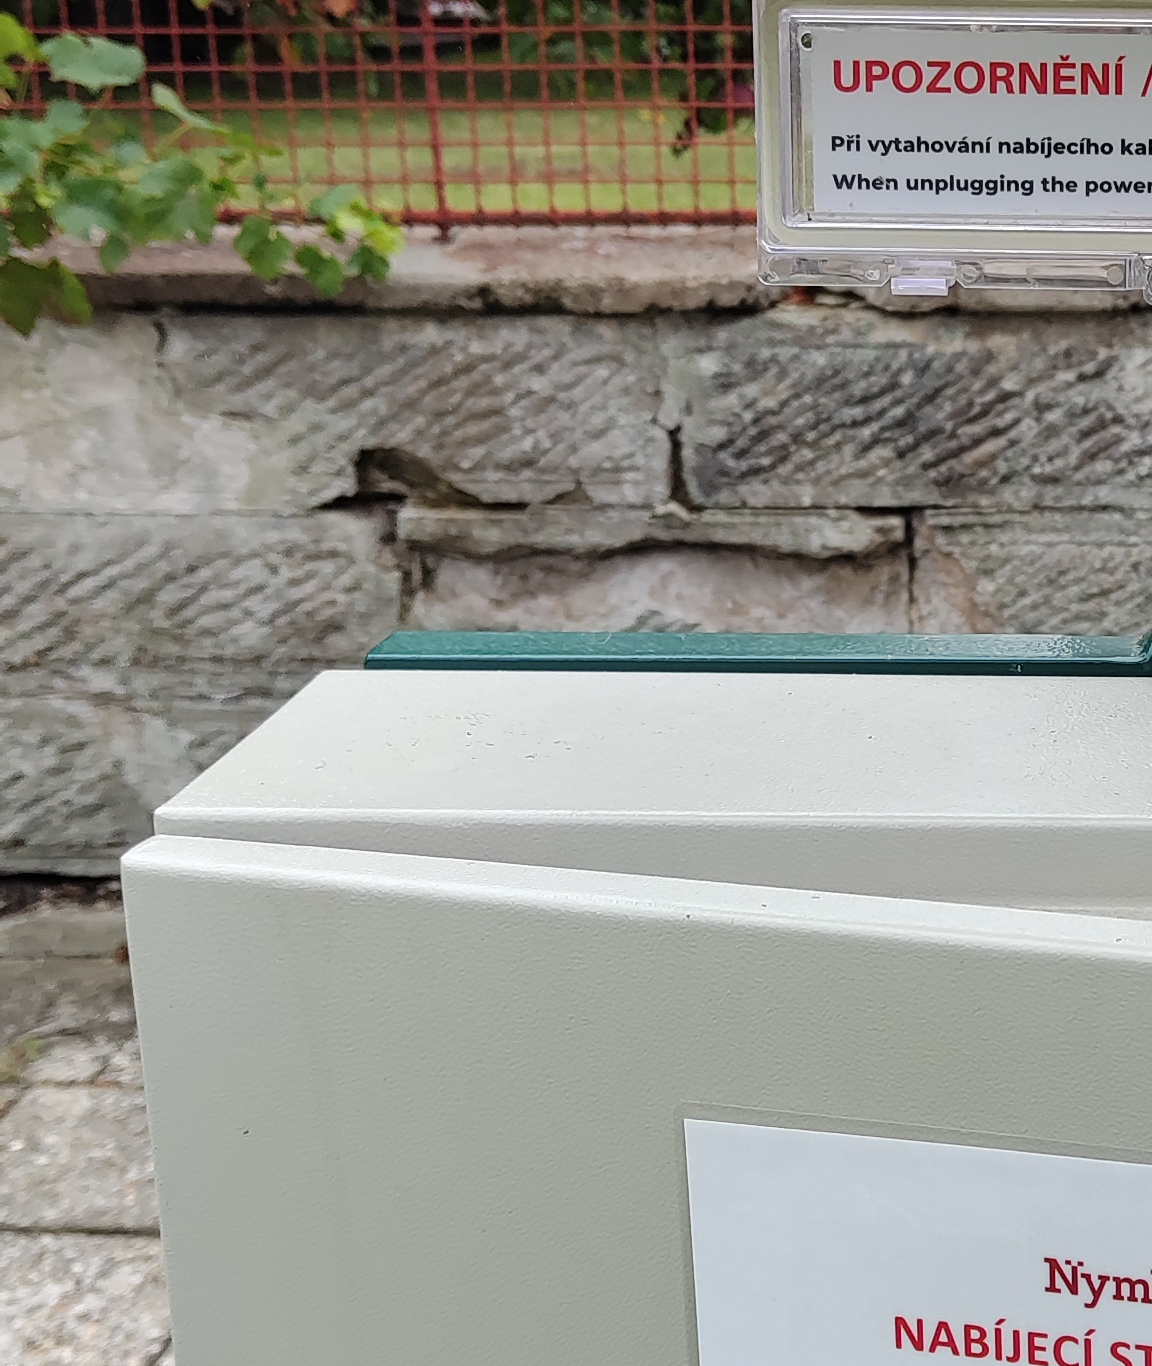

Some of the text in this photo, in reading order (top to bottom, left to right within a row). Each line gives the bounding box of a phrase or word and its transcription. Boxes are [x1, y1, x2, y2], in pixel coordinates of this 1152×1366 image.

[833, 55, 1127, 96] UPOZORNĚNÍ
[831, 134, 860, 152] Při
[867, 136, 992, 156] vytahování
[998, 136, 1113, 159] nabíjecího
[832, 173, 898, 191] When
[906, 174, 1034, 196] unplugging
[1041, 176, 1078, 193] the
